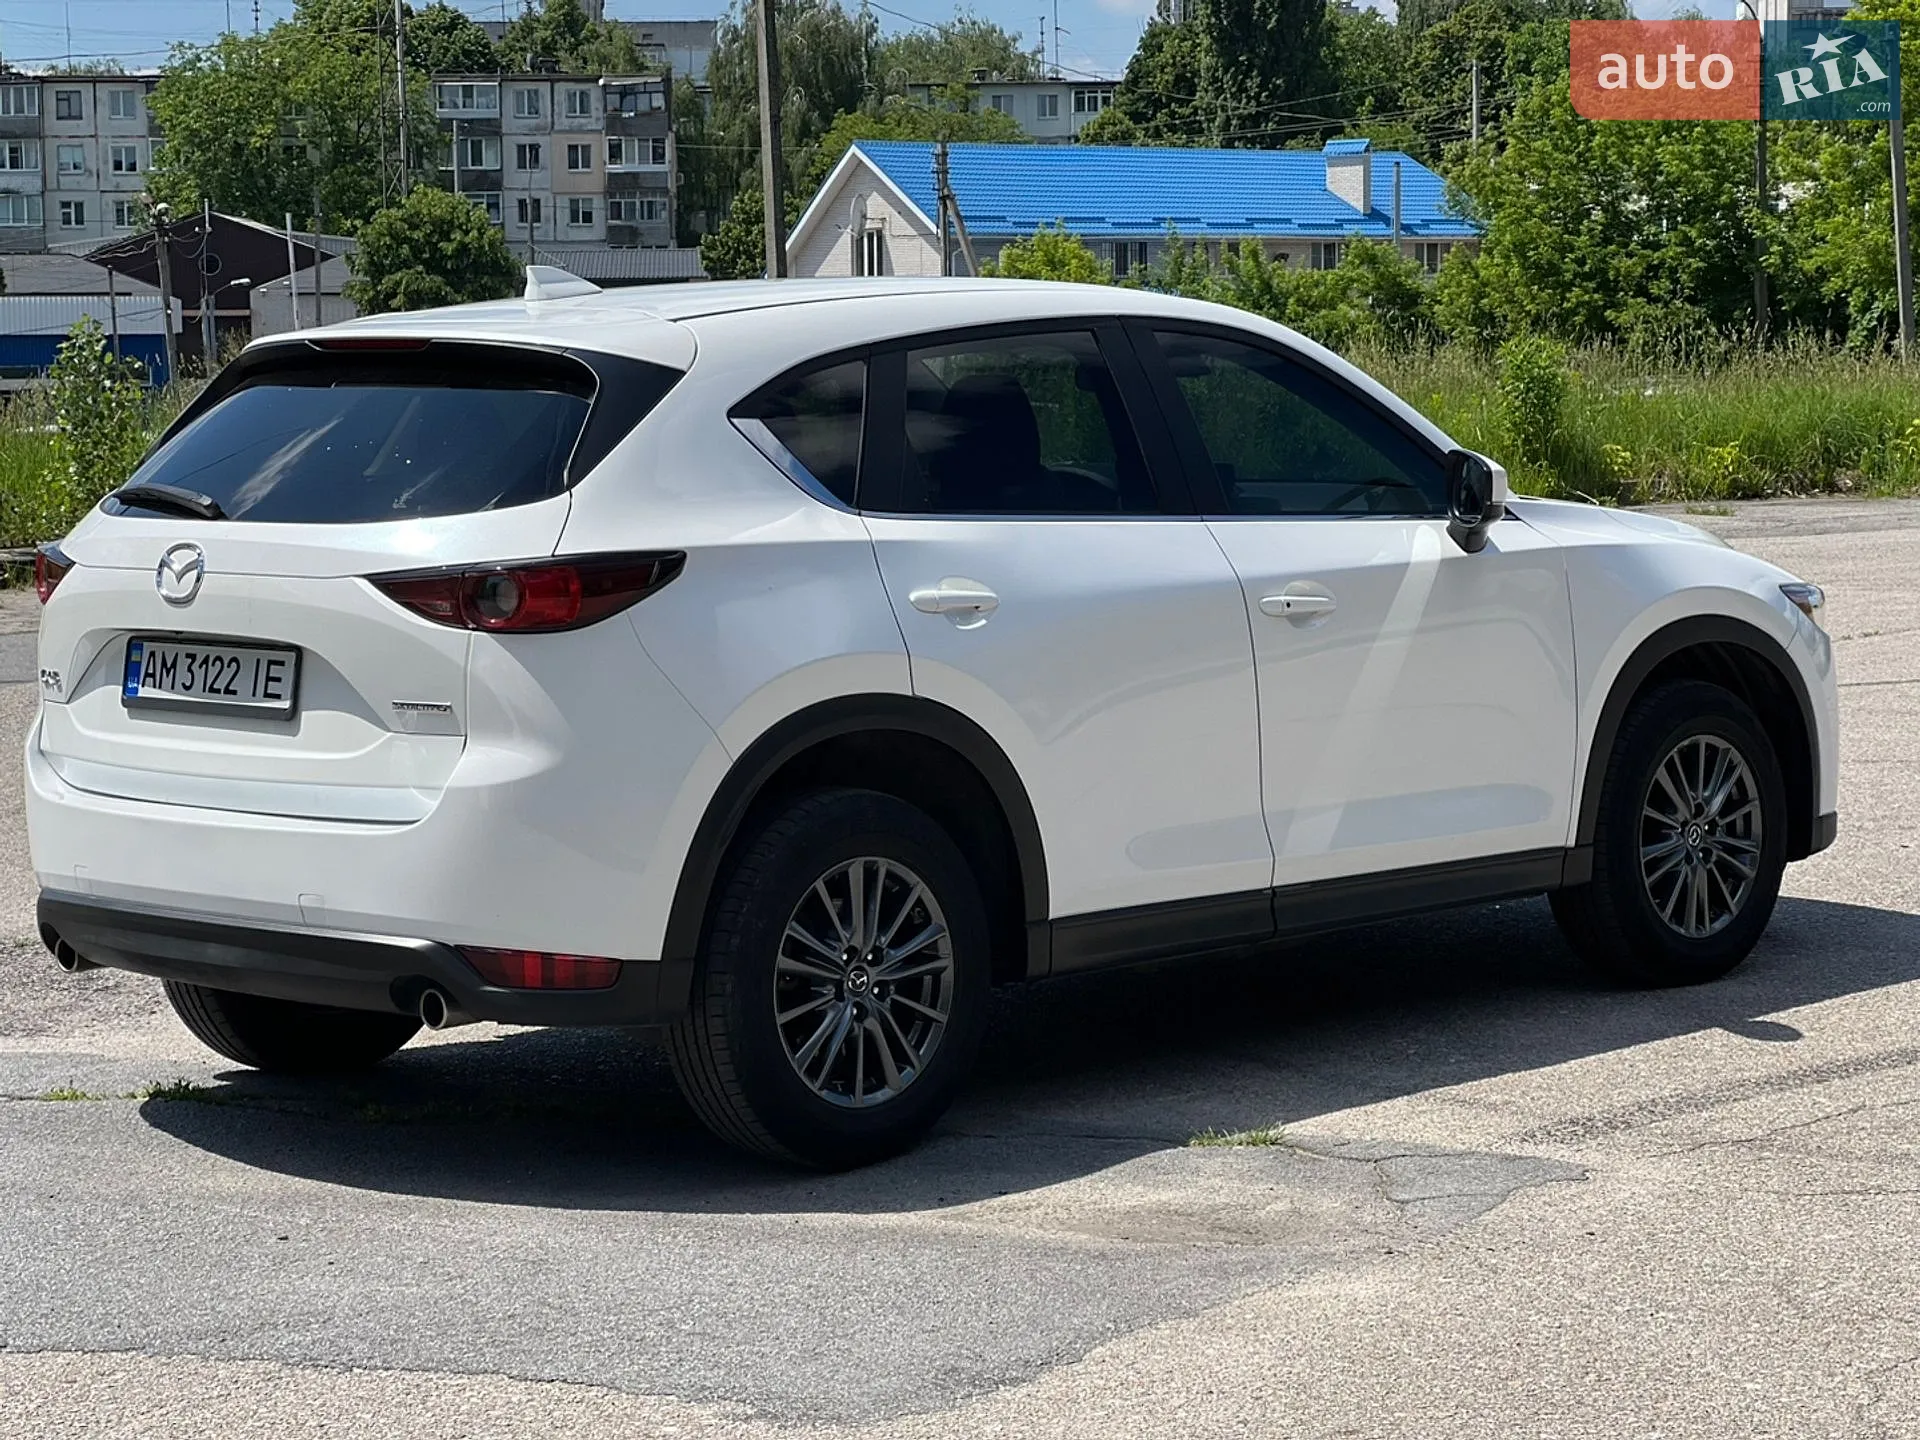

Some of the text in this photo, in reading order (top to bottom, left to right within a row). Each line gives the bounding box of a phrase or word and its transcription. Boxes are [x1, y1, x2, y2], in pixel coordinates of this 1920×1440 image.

[141, 649, 286, 700] AM 3122 IE
